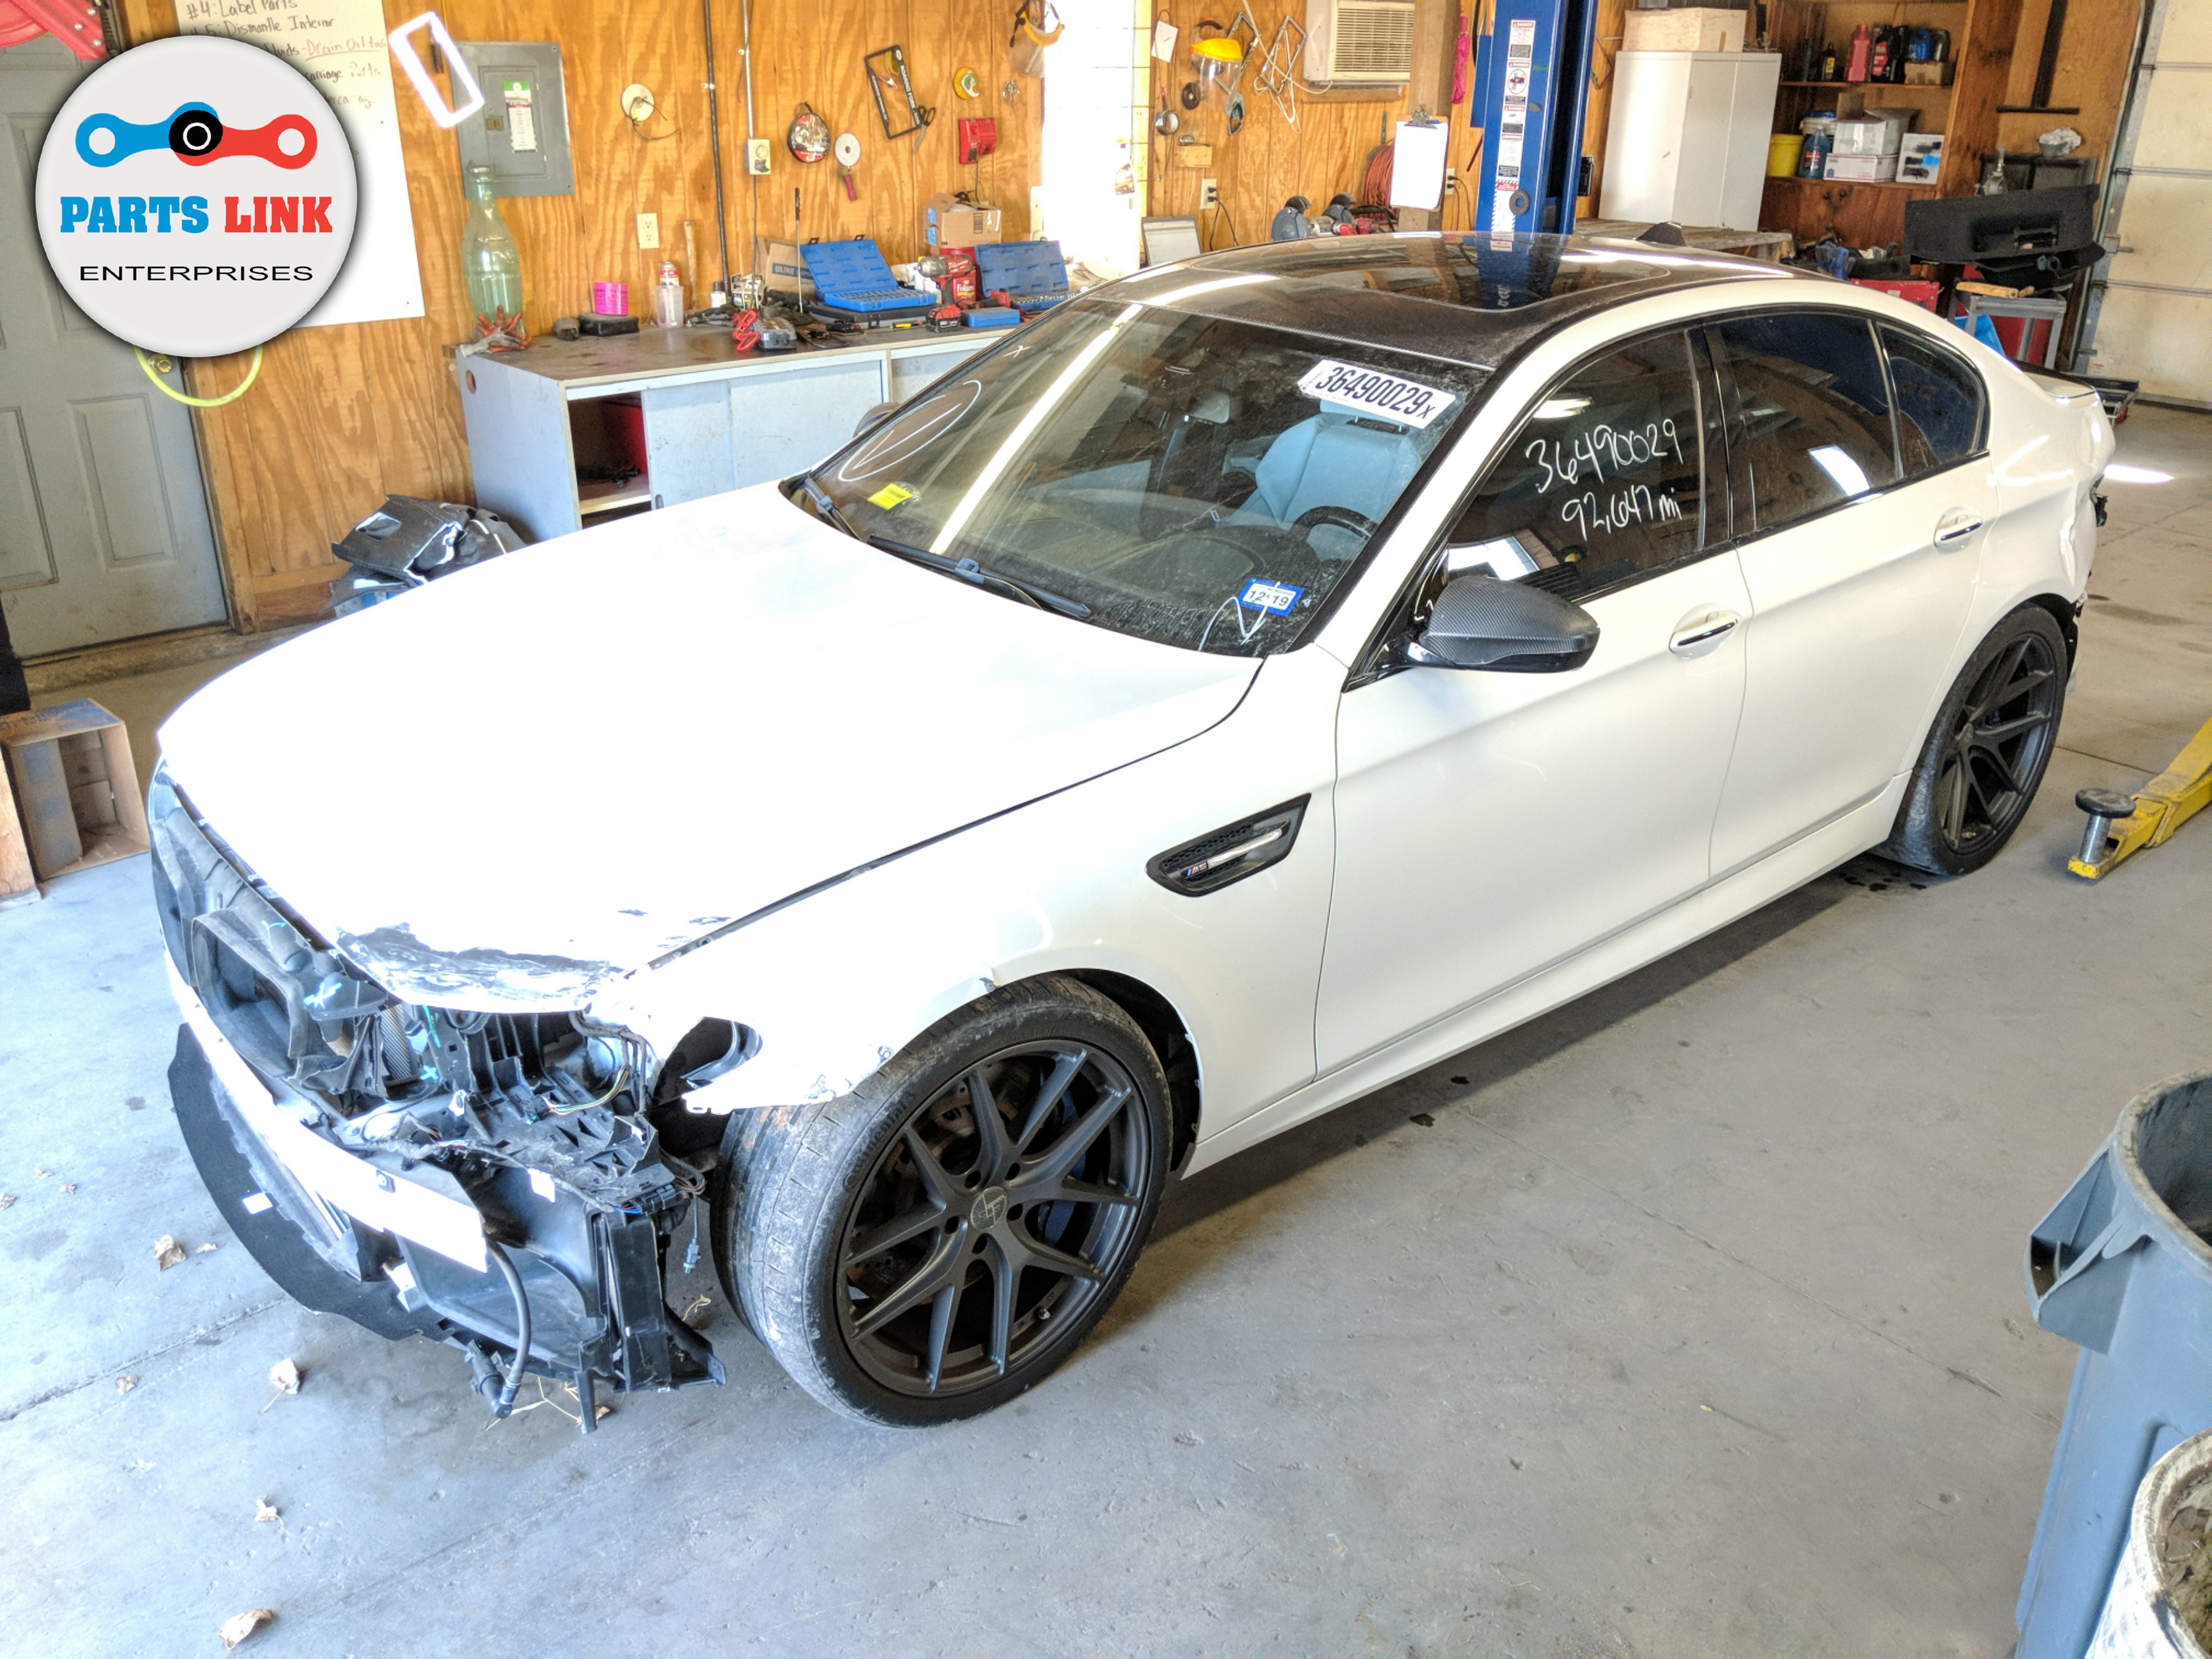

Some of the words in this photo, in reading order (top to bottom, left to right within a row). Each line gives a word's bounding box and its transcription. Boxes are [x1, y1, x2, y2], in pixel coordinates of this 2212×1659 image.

[221, 0, 256, 18] Label
[224, 17, 282, 37] Dismantle
[288, 15, 335, 31] Interior
[346, 35, 365, 50] Oil
[908, 92, 916, 109] FORK
[775, 265, 795, 275] ULINE
[1524, 418, 1684, 493] 36490029
[1249, 590, 1266, 602] 12
[1272, 595, 1289, 606] 19
